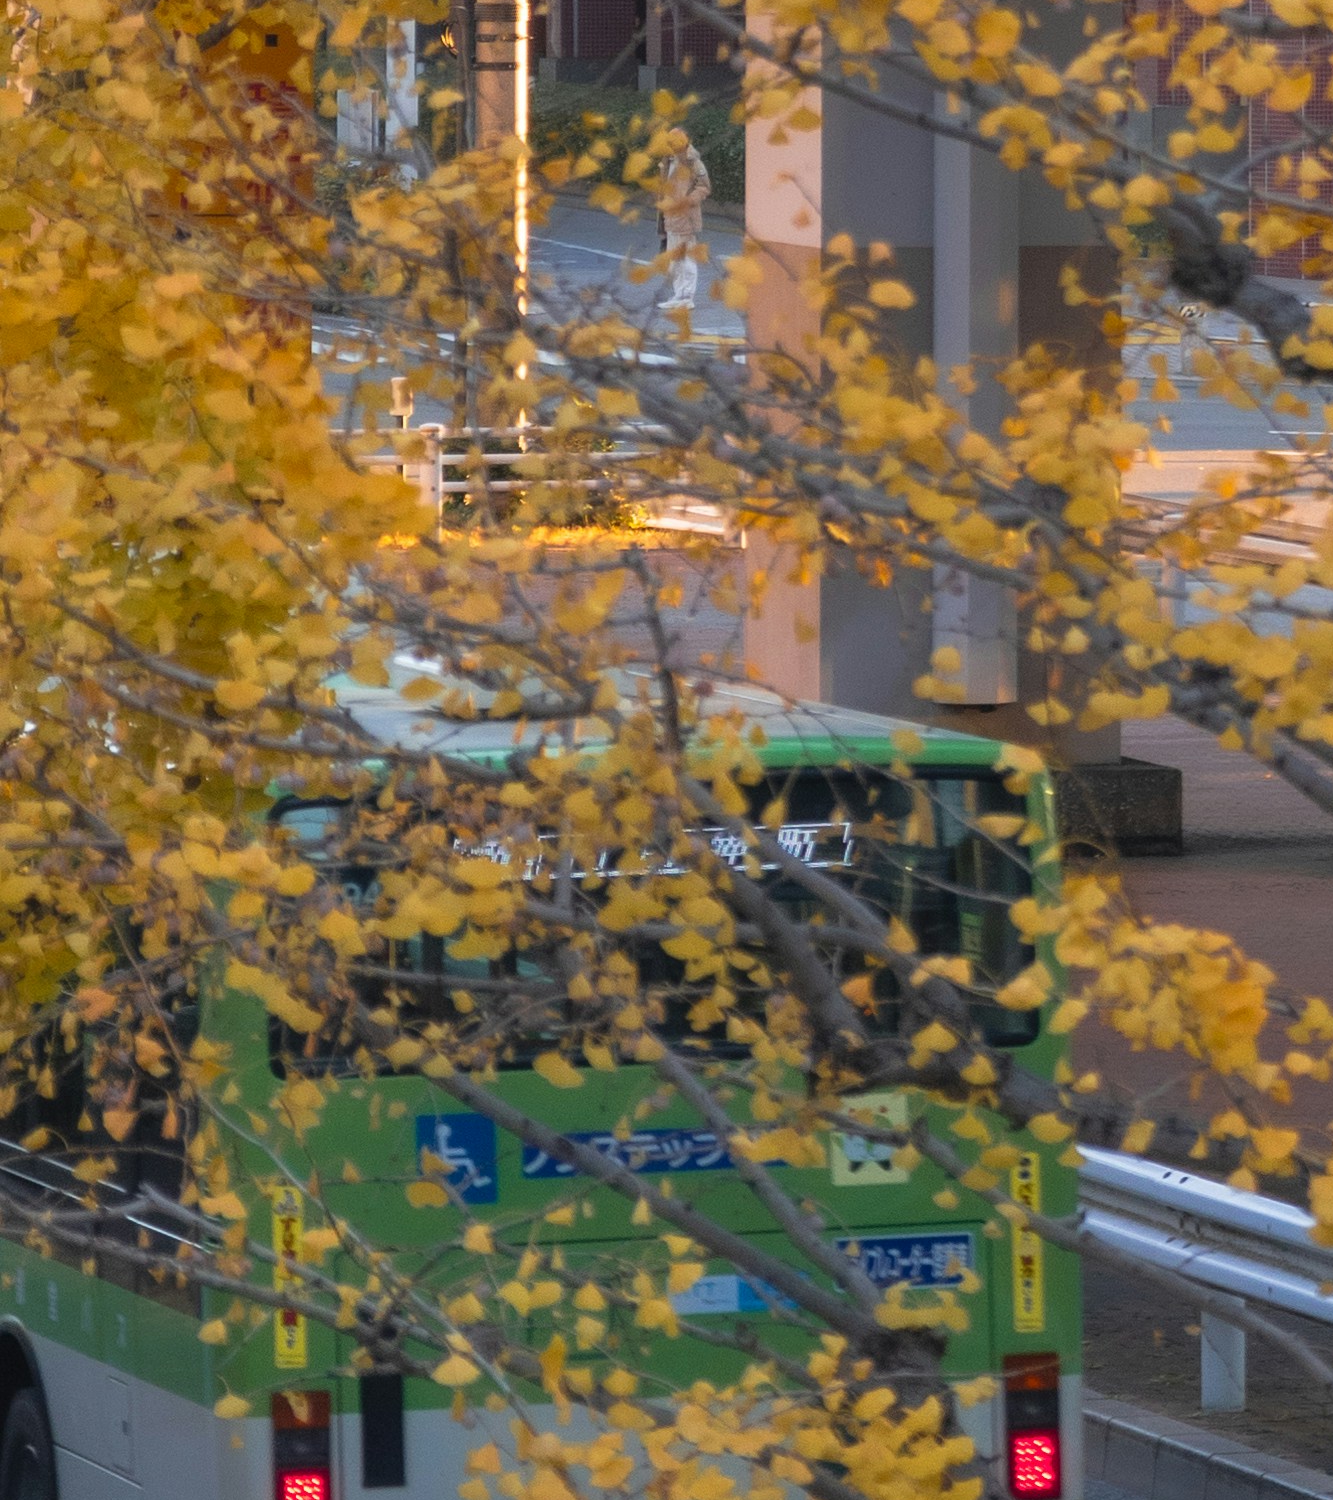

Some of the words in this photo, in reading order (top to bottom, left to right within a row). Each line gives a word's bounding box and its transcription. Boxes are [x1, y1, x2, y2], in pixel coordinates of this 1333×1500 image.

[523, 1132, 795, 1175] ノステップ
